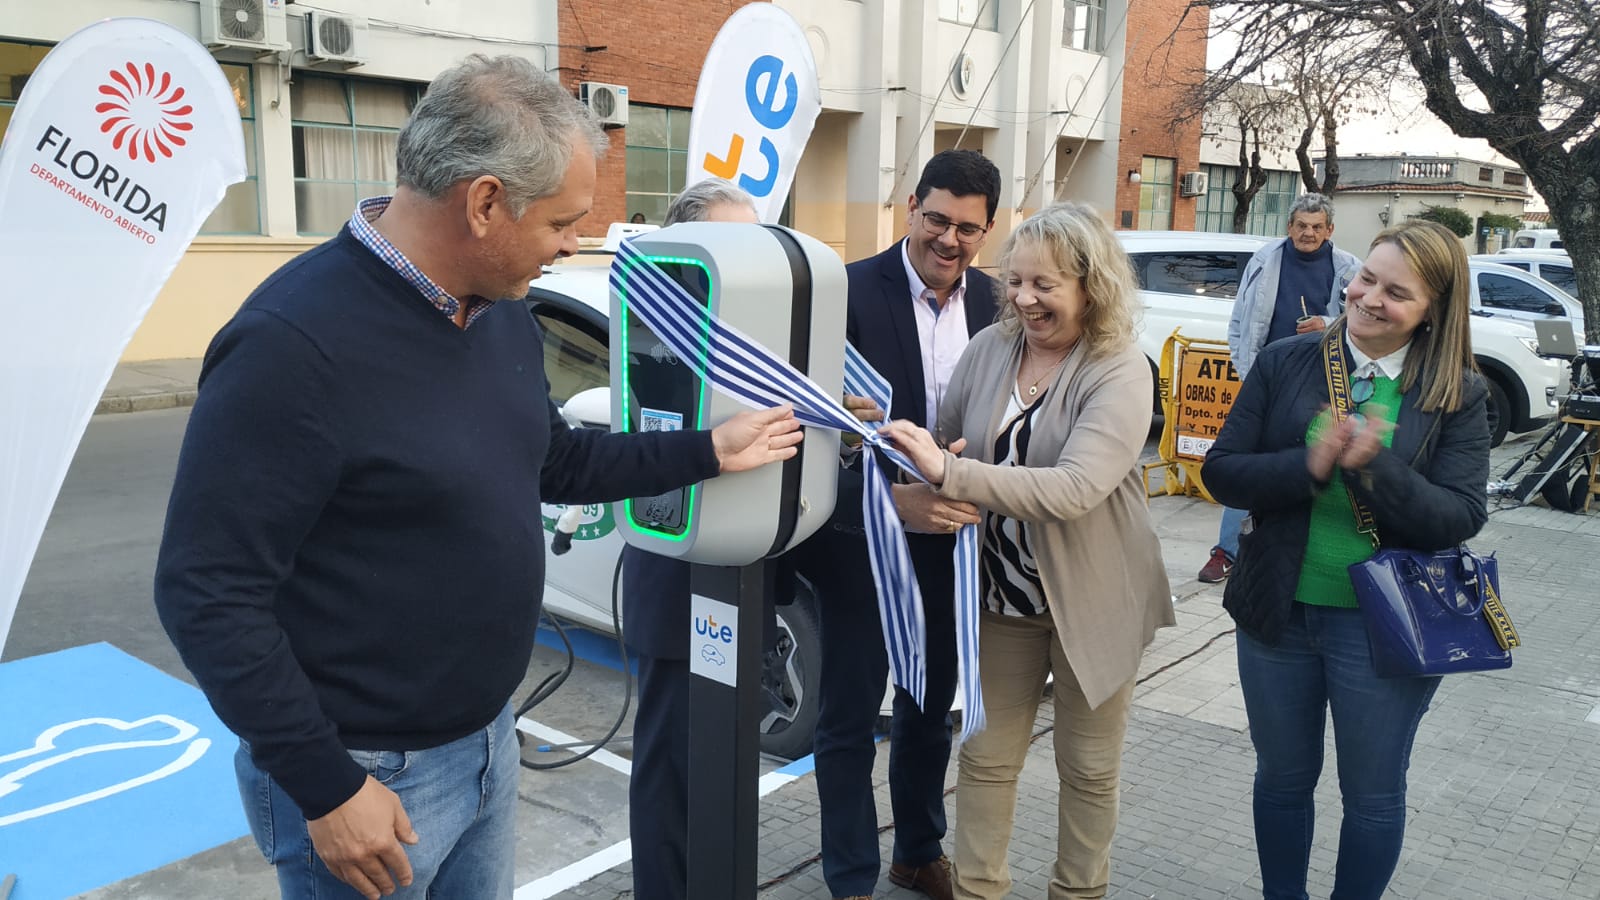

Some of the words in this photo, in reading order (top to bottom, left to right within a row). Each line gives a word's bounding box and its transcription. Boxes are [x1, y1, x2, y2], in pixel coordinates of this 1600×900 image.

[36, 125, 167, 232] FLORIDA
[30, 163, 114, 219] DEPARTAMENTO
[113, 216, 156, 245] ABIERTO
[1198, 359, 1239, 381] ATE
[1331, 361, 1345, 394] PETITE
[1185, 384, 1216, 403] OBRAS
[1221, 388, 1232, 405] de
[1185, 406, 1213, 419] Dpto.
[1203, 425, 1219, 435] TR
[695, 615, 733, 643] ute
